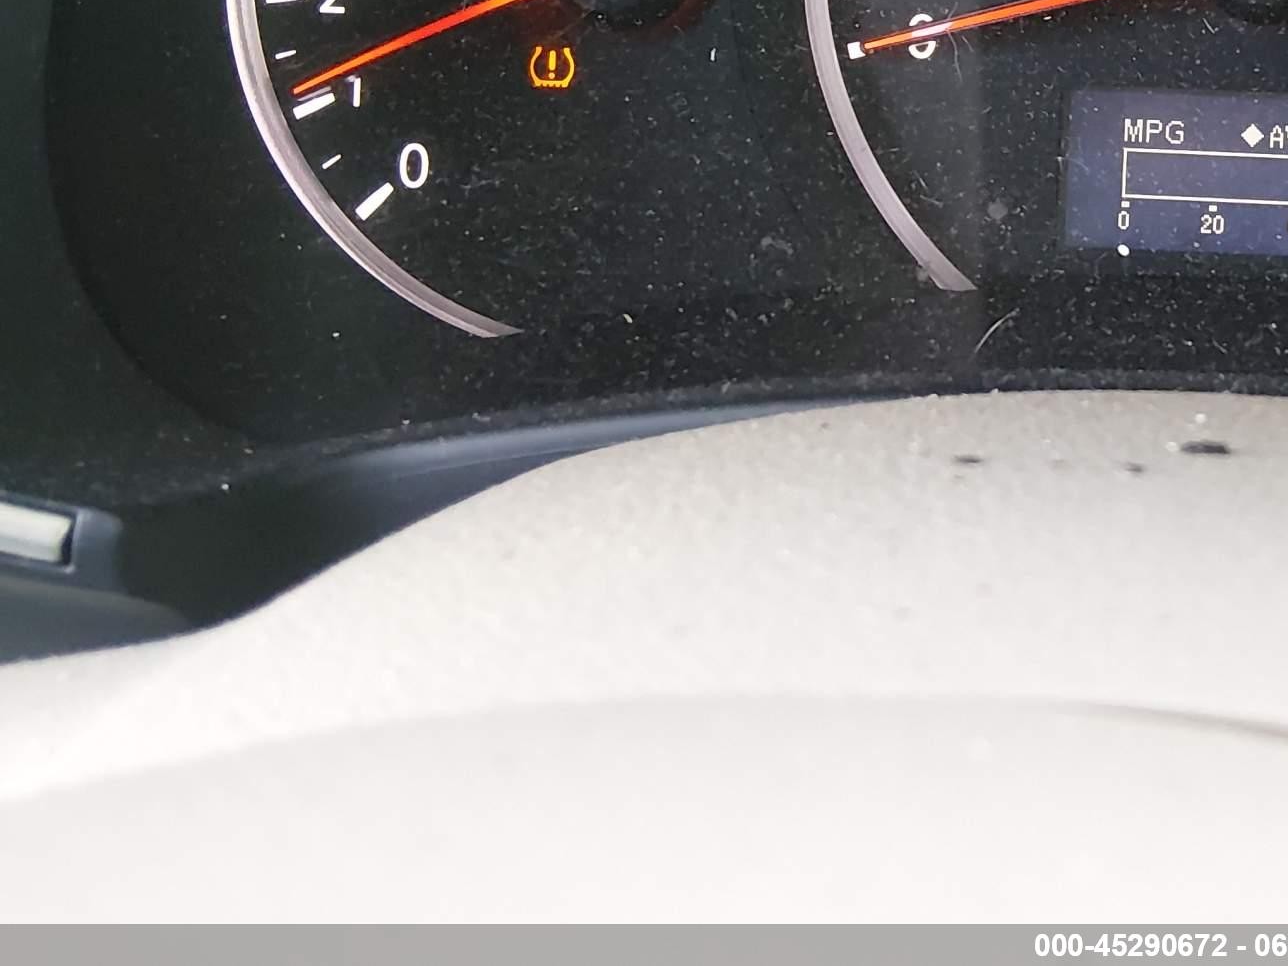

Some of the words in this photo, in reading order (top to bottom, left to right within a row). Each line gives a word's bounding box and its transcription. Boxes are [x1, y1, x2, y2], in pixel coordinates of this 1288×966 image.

[1123, 118, 1185, 145] MPG
[399, 142, 430, 189] 0
[1117, 210, 1130, 230] 0
[1200, 215, 1225, 235] 20
